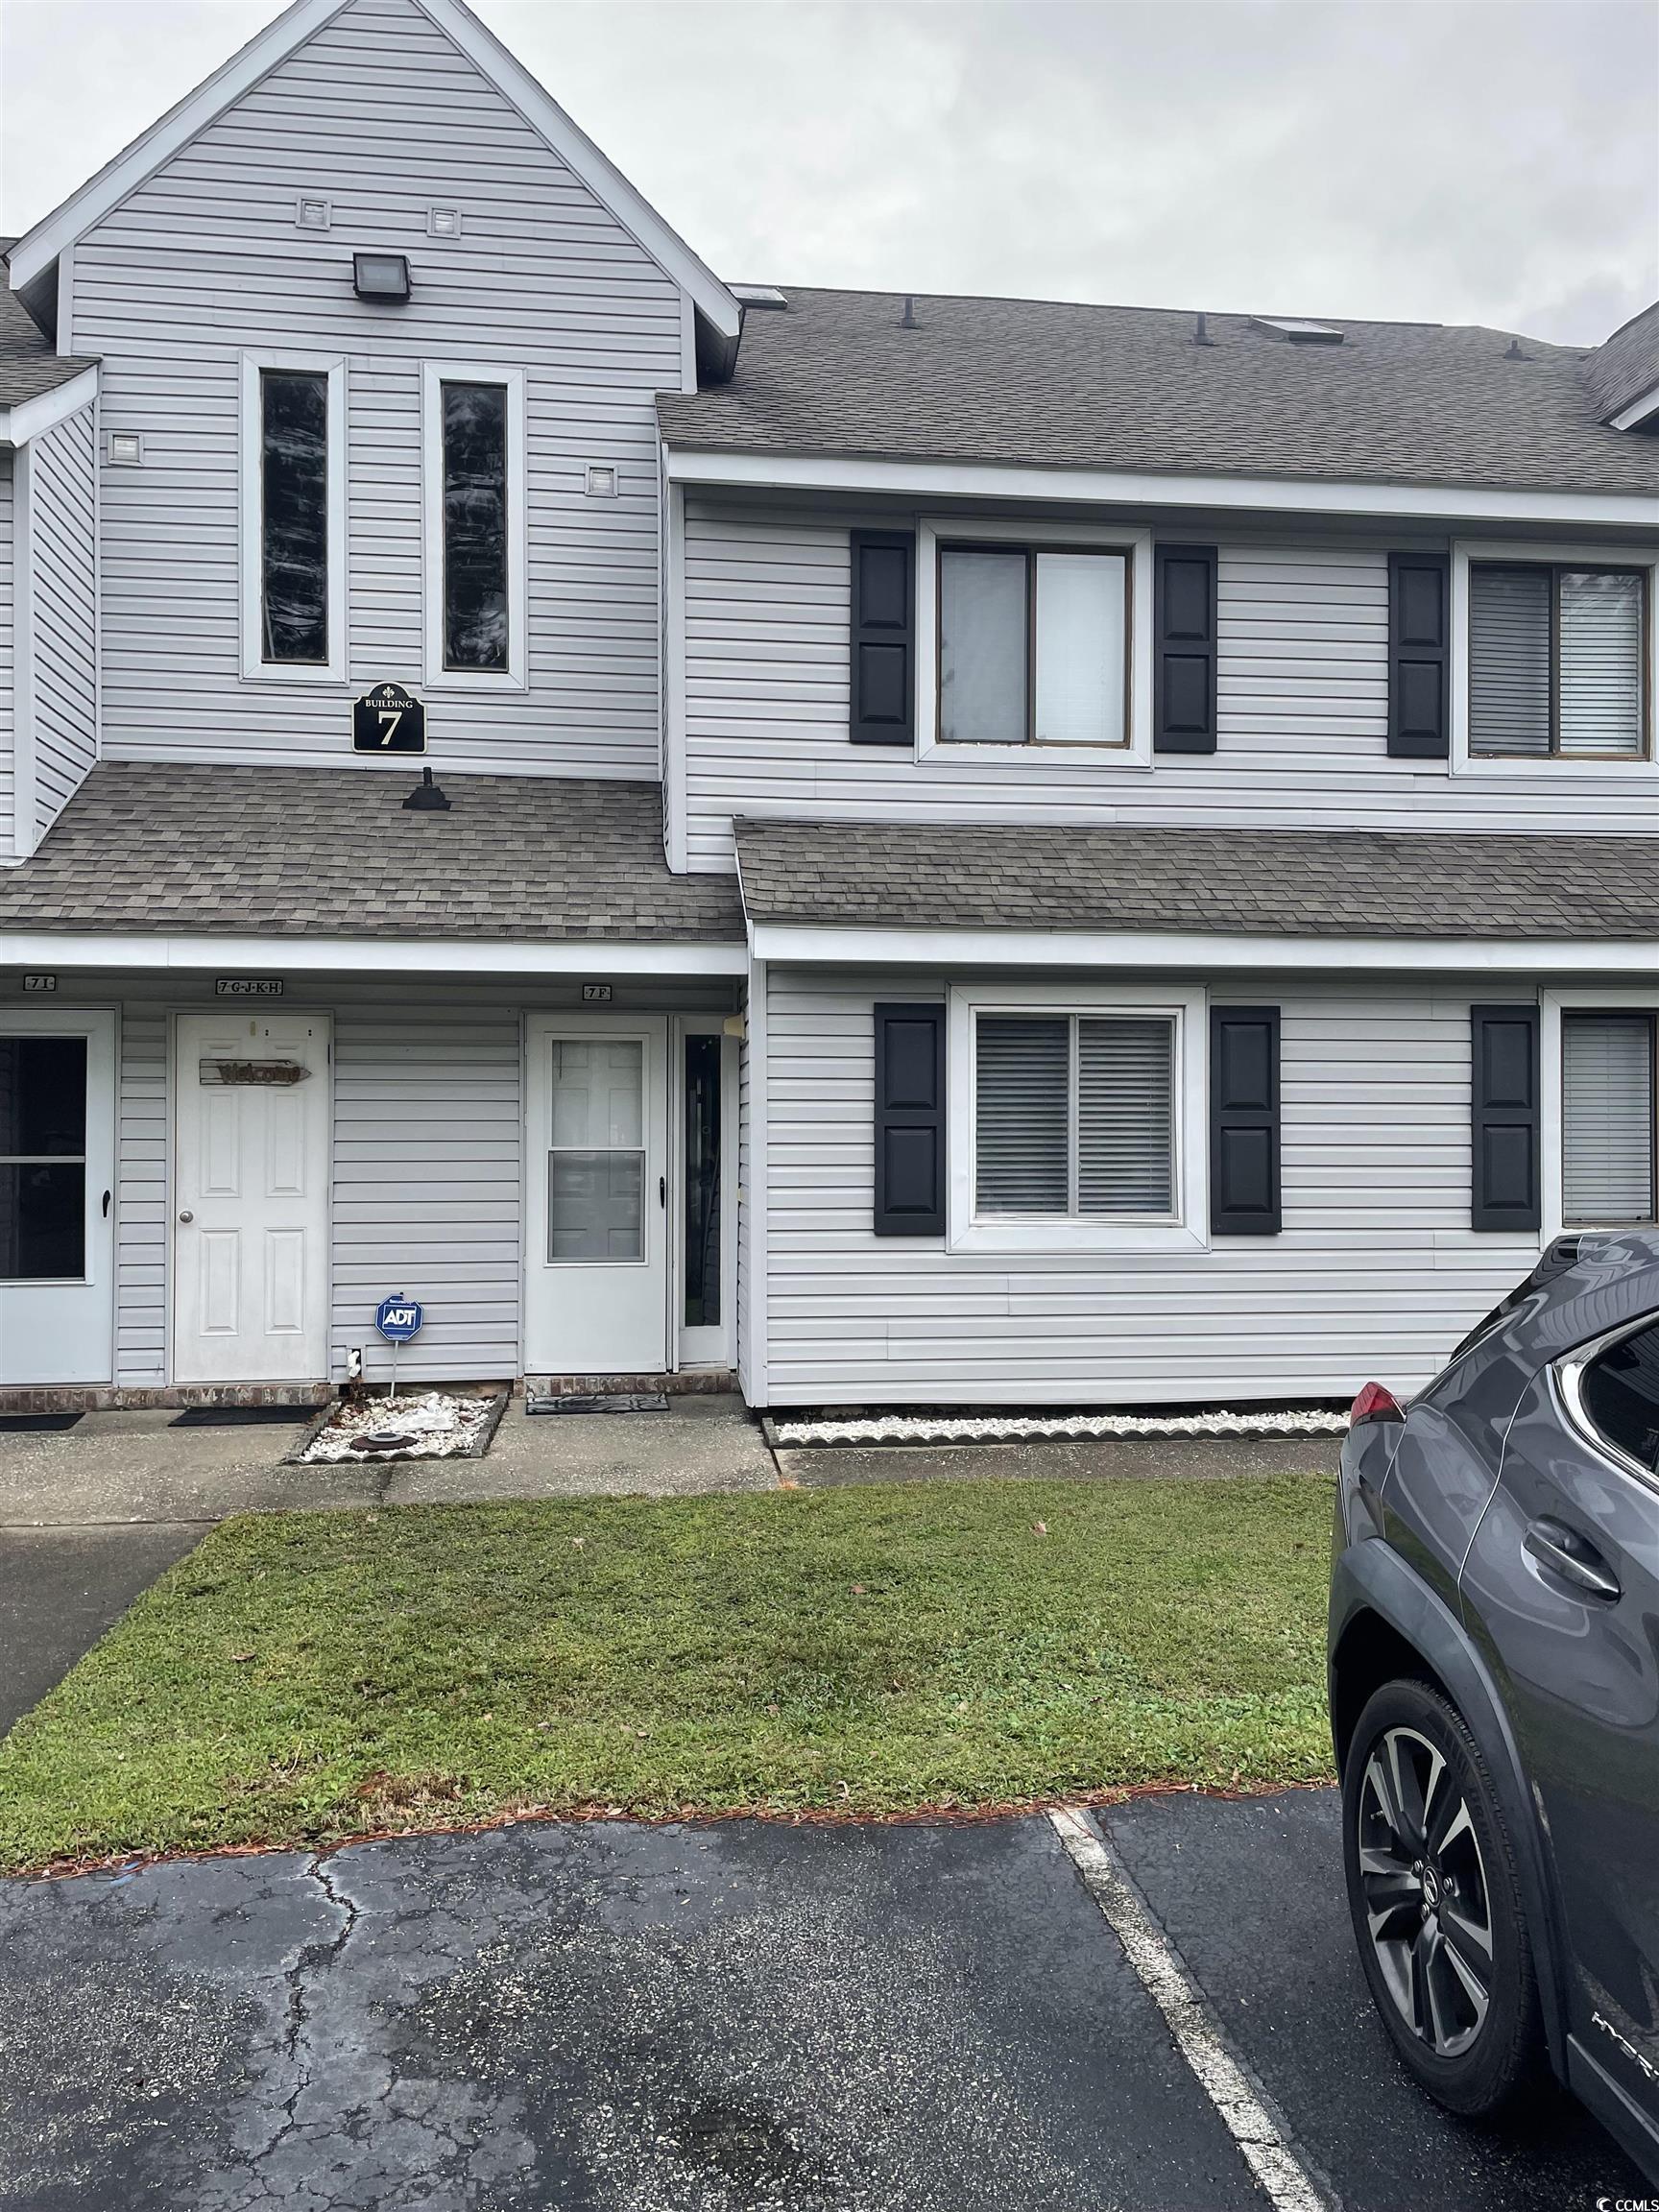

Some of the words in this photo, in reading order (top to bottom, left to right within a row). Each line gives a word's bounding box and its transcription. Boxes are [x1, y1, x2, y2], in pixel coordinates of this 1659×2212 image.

[365, 699, 413, 709] BUILDING
[378, 710, 402, 745] 7
[383, 1309, 417, 1326] ADT
